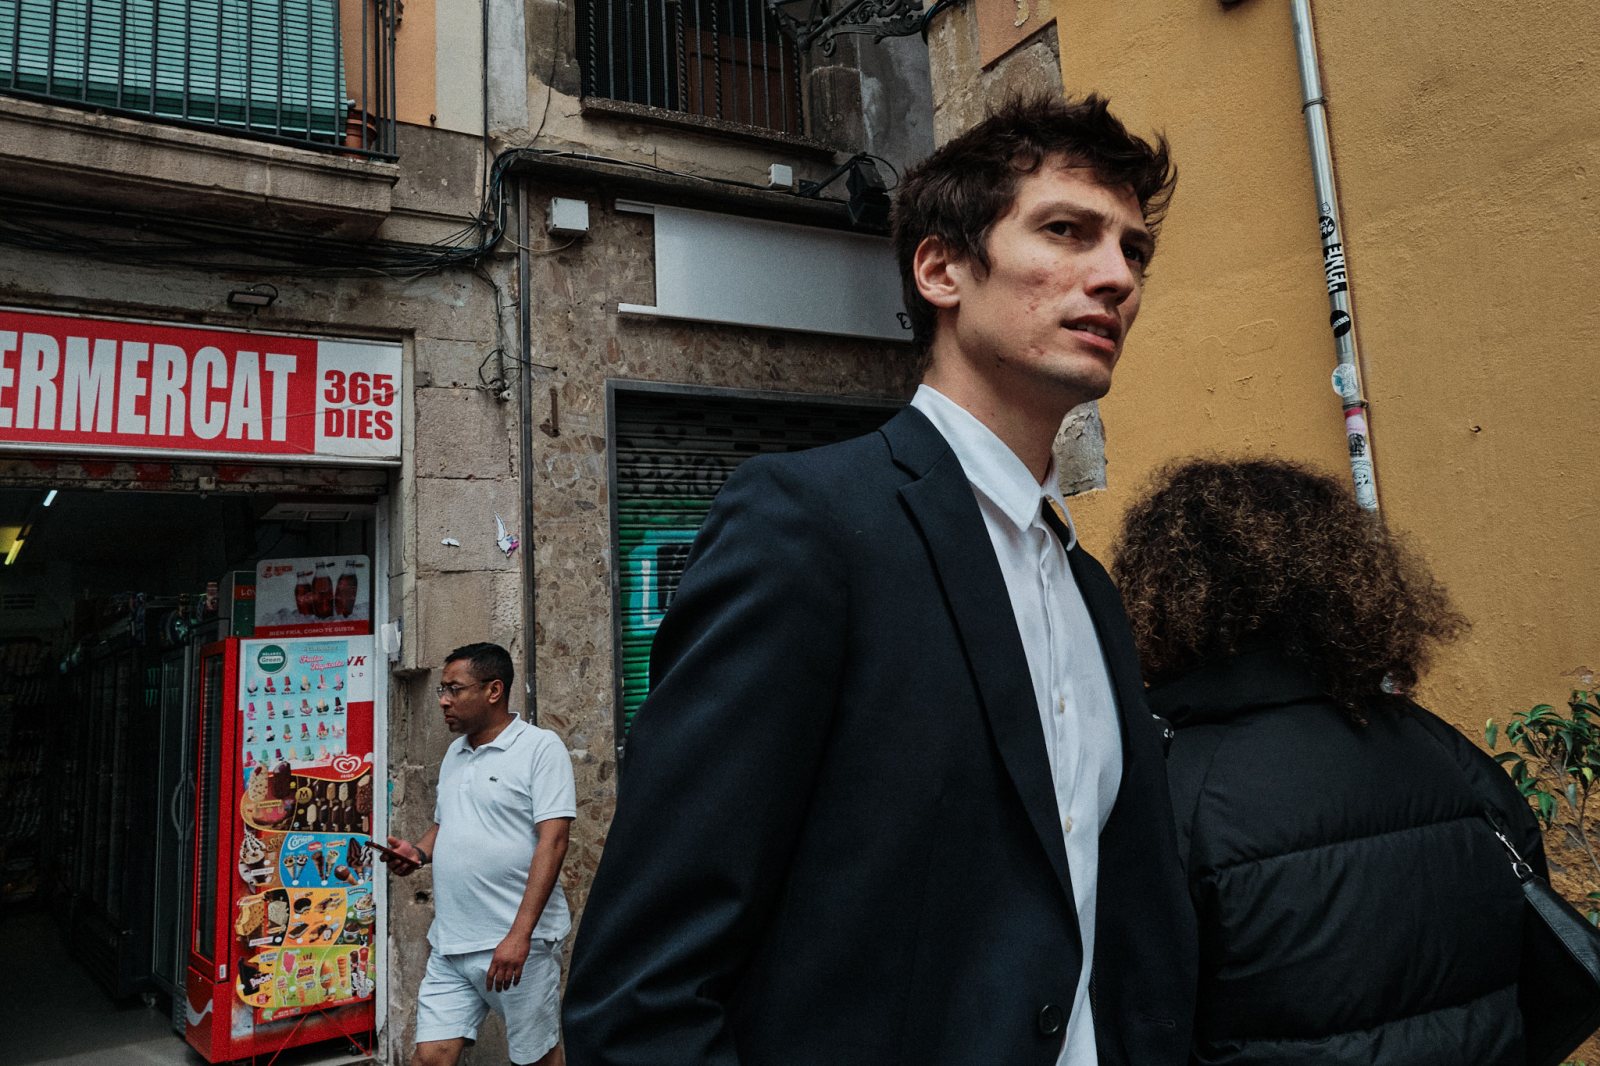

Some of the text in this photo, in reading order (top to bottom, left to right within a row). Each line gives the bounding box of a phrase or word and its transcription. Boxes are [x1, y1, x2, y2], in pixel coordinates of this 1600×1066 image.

[323, 369, 394, 408] 365
[323, 407, 394, 441] DIES
[303, 627, 323, 635] COMO
[334, 625, 355, 634] GUSTA
